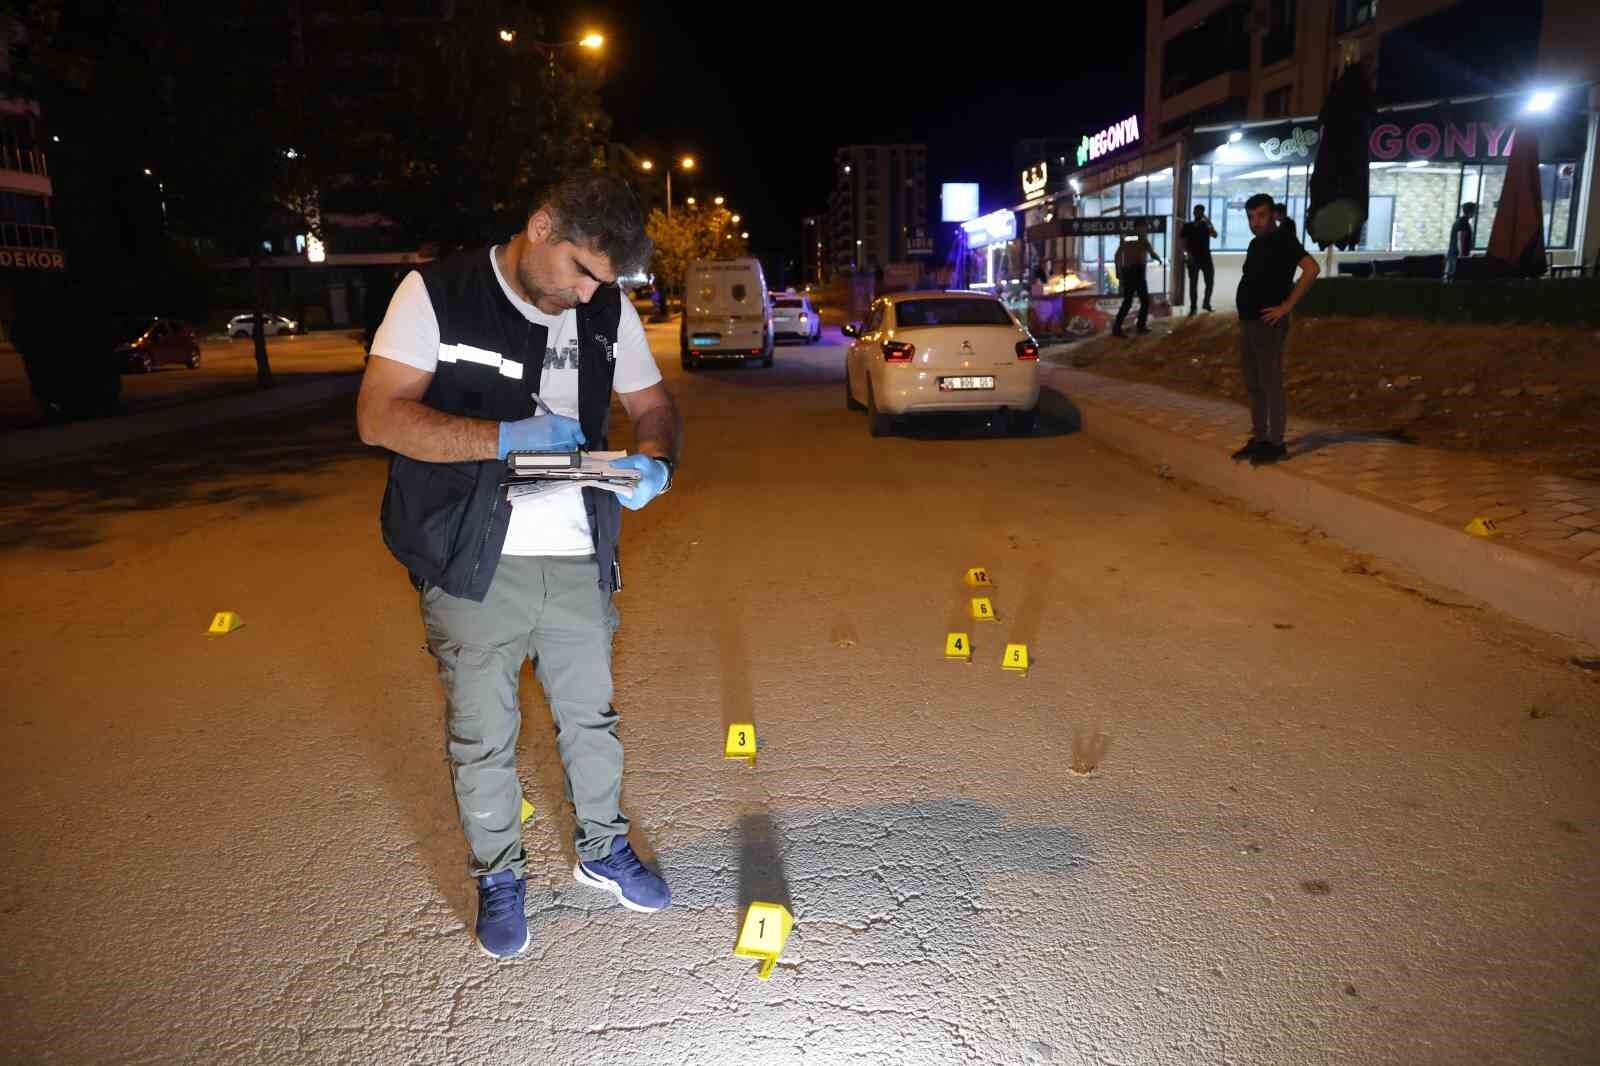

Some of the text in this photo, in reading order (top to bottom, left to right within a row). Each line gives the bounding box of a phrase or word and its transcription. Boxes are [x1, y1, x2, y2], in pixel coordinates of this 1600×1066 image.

[1089, 114, 1140, 160] BEGONYA
[0, 251, 65, 269] DEKOR
[974, 571, 987, 582] 12
[954, 637, 963, 650] 4
[1013, 649, 1020, 662] 5
[738, 731, 746, 746] 3
[759, 917, 766, 939] 1
